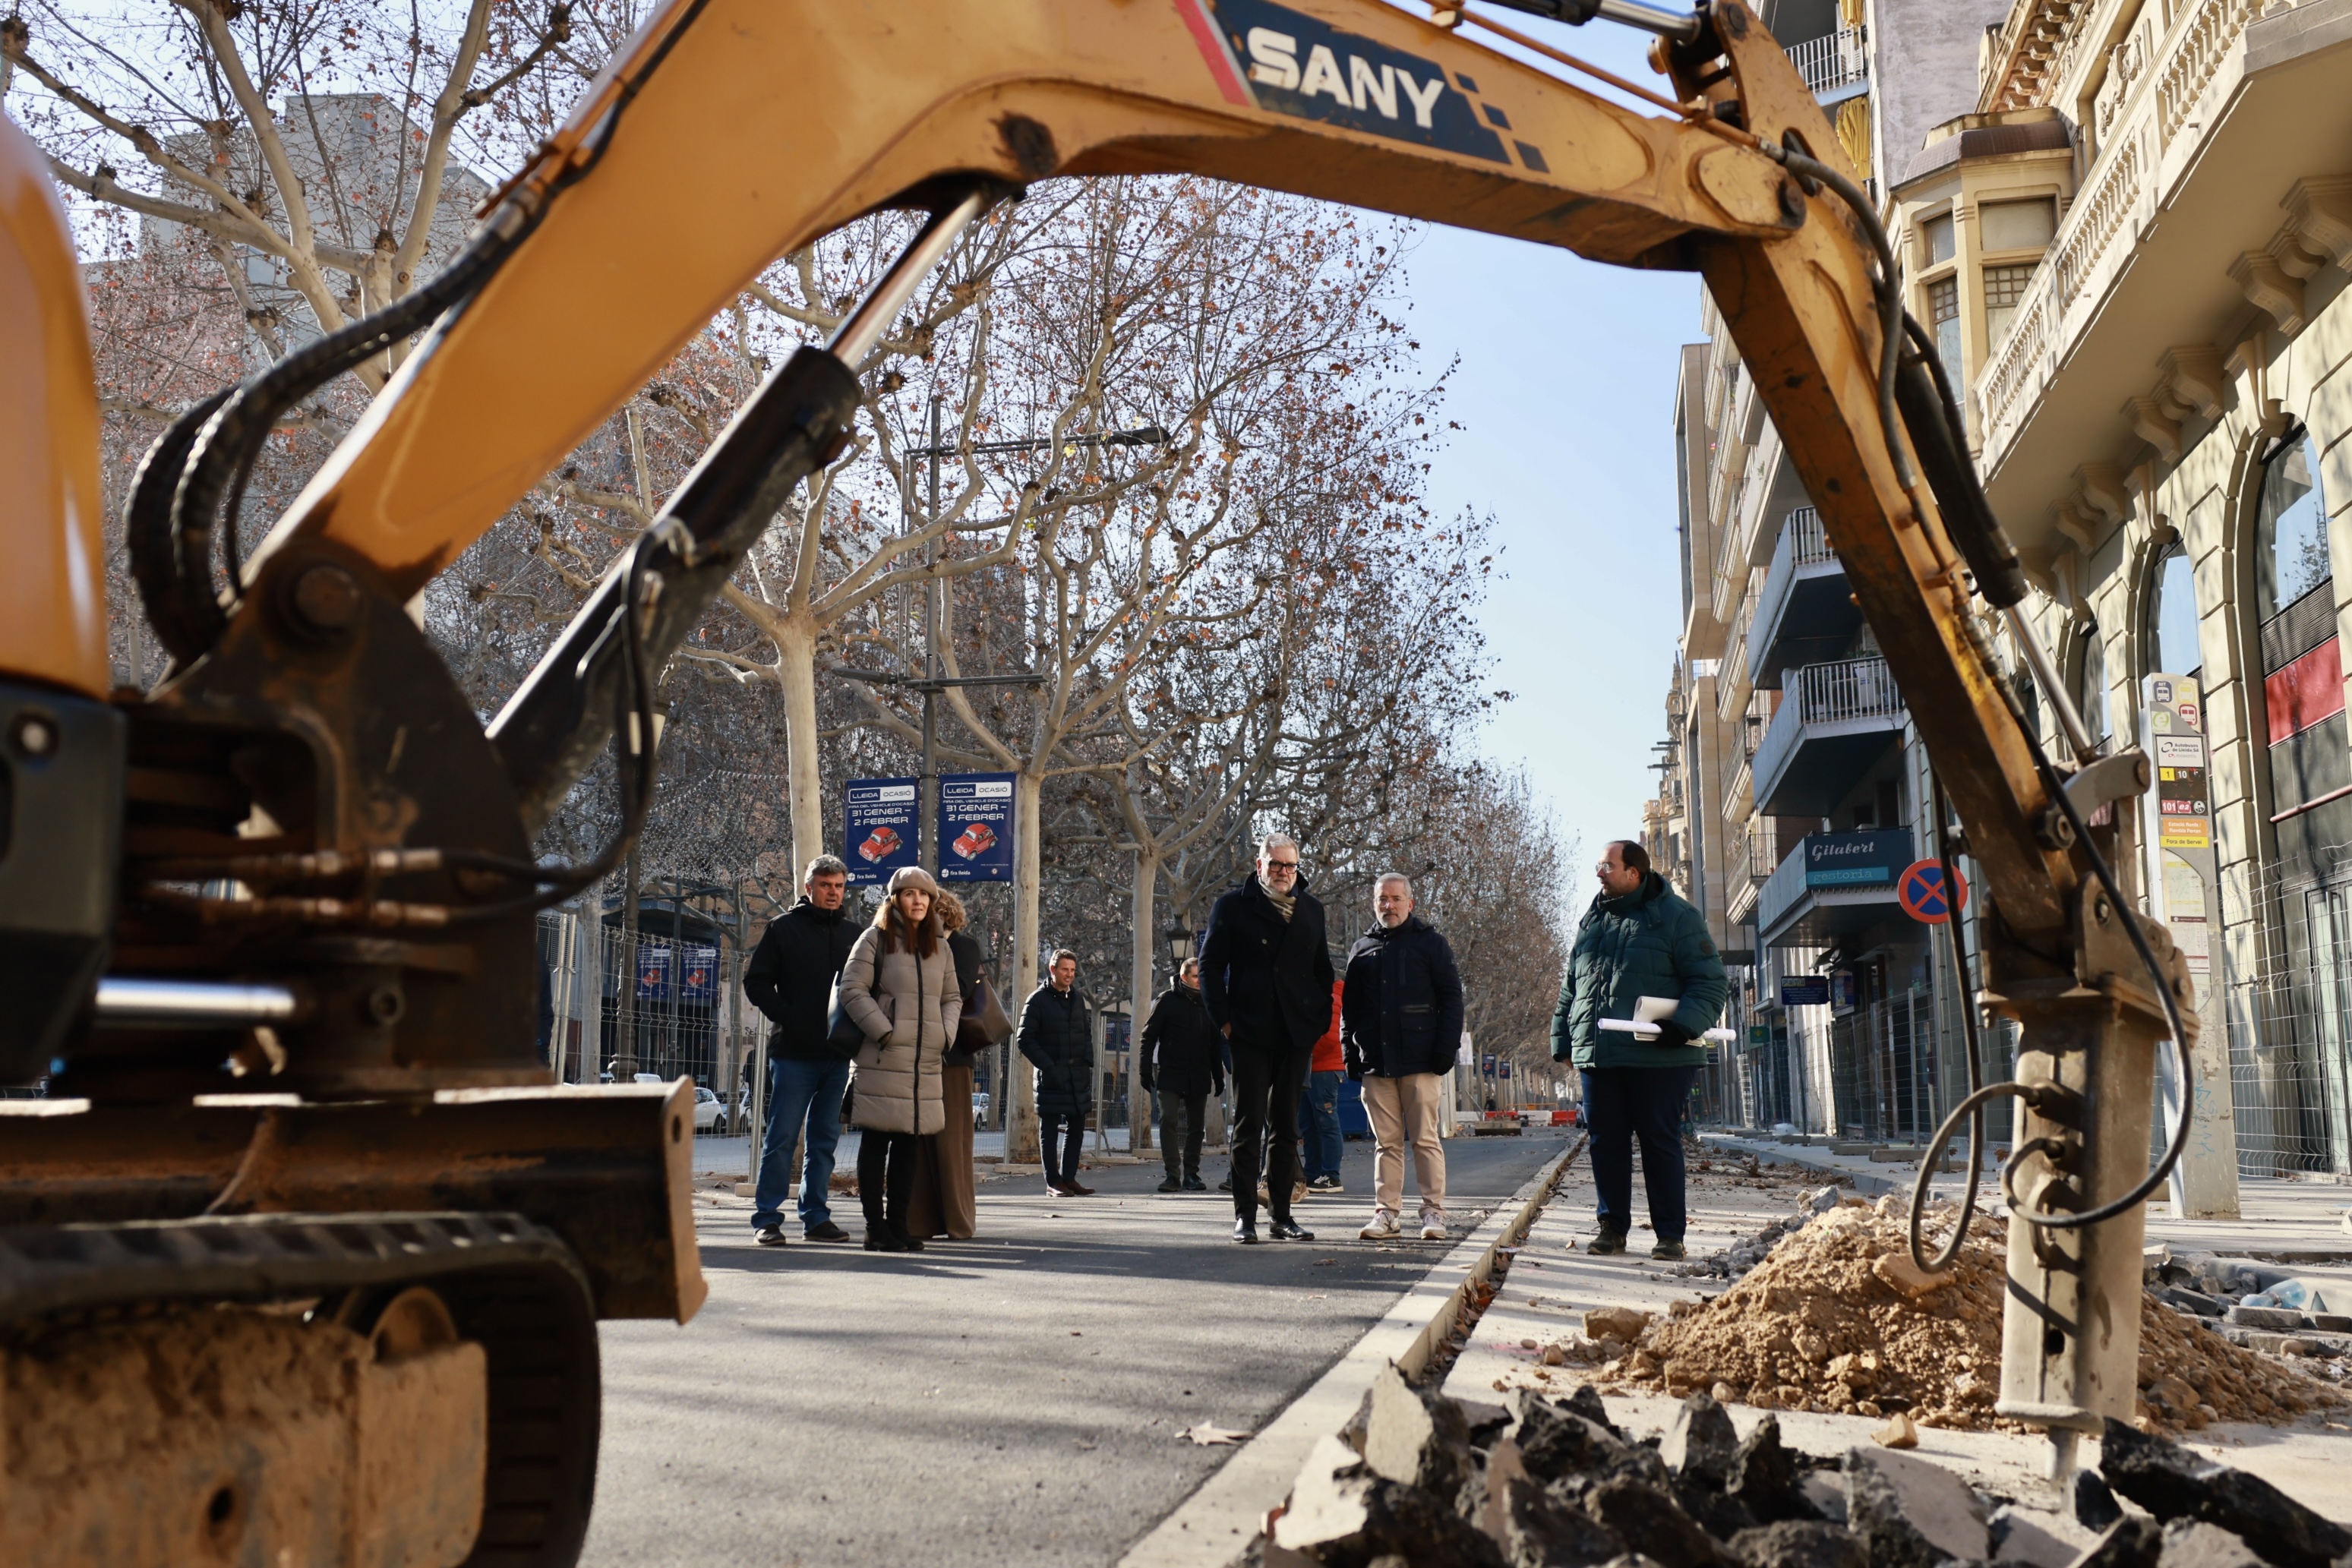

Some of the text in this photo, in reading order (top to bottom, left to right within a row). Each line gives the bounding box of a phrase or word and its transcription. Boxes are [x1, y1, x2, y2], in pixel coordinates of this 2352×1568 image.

[1247, 27, 1444, 130] SANY
[2177, 770, 2187, 779] 10
[863, 807, 902, 816] GENER
[958, 803, 998, 812] GENER
[2162, 802, 2176, 812] 101
[863, 816, 909, 825] FEBRER
[1811, 841, 1874, 861] Gilabert
[1813, 869, 1873, 884] gestoria
